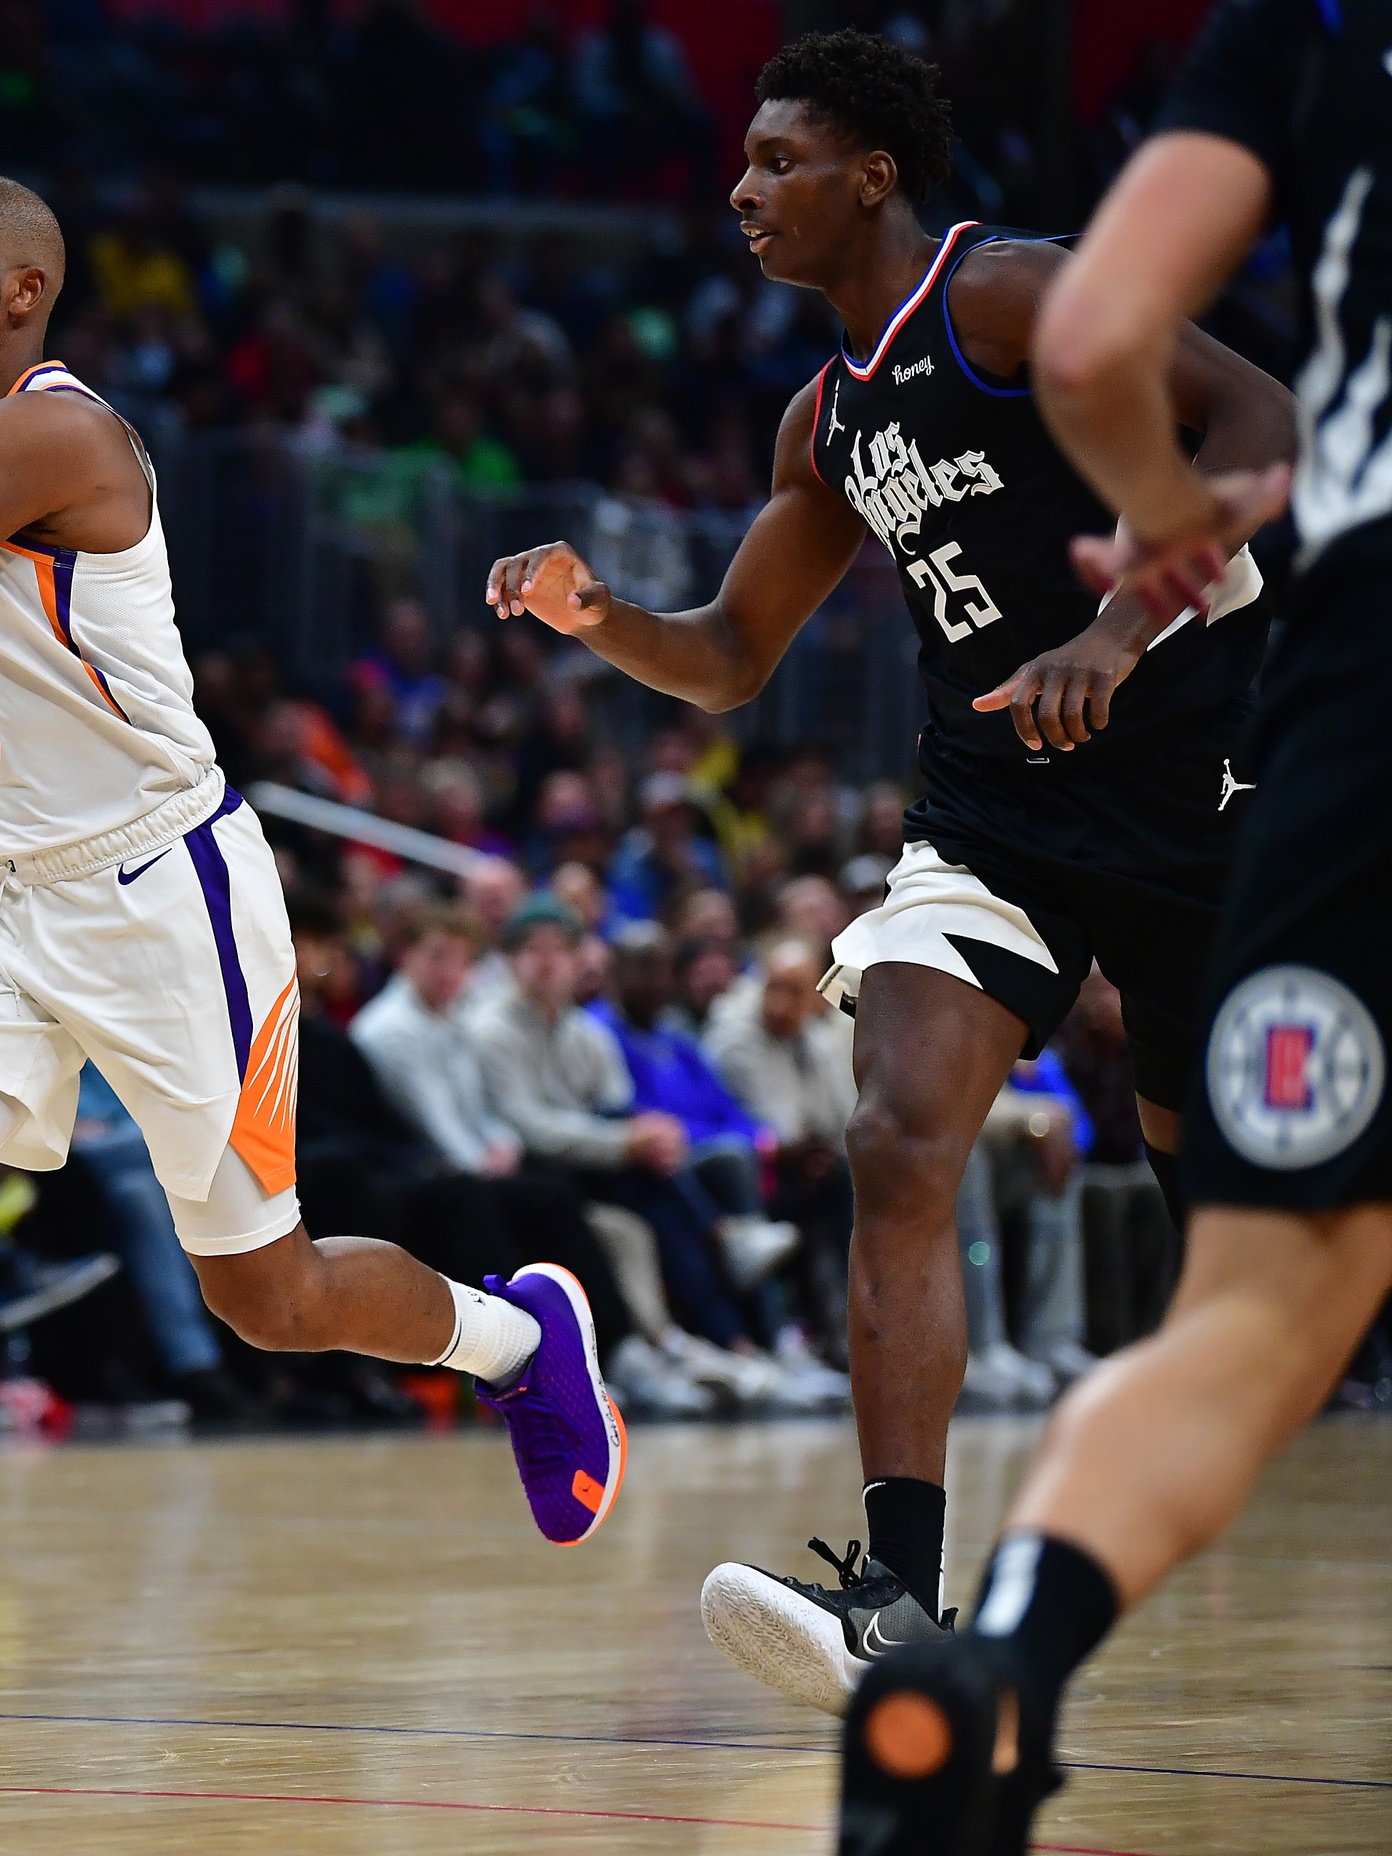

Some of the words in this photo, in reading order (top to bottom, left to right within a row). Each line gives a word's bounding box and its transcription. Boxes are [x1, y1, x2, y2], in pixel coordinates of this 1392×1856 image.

[891, 355, 935, 385] honey
[844, 438, 1005, 561] Angeles
[851, 421, 910, 500] Los
[906, 541, 1003, 643] 25
